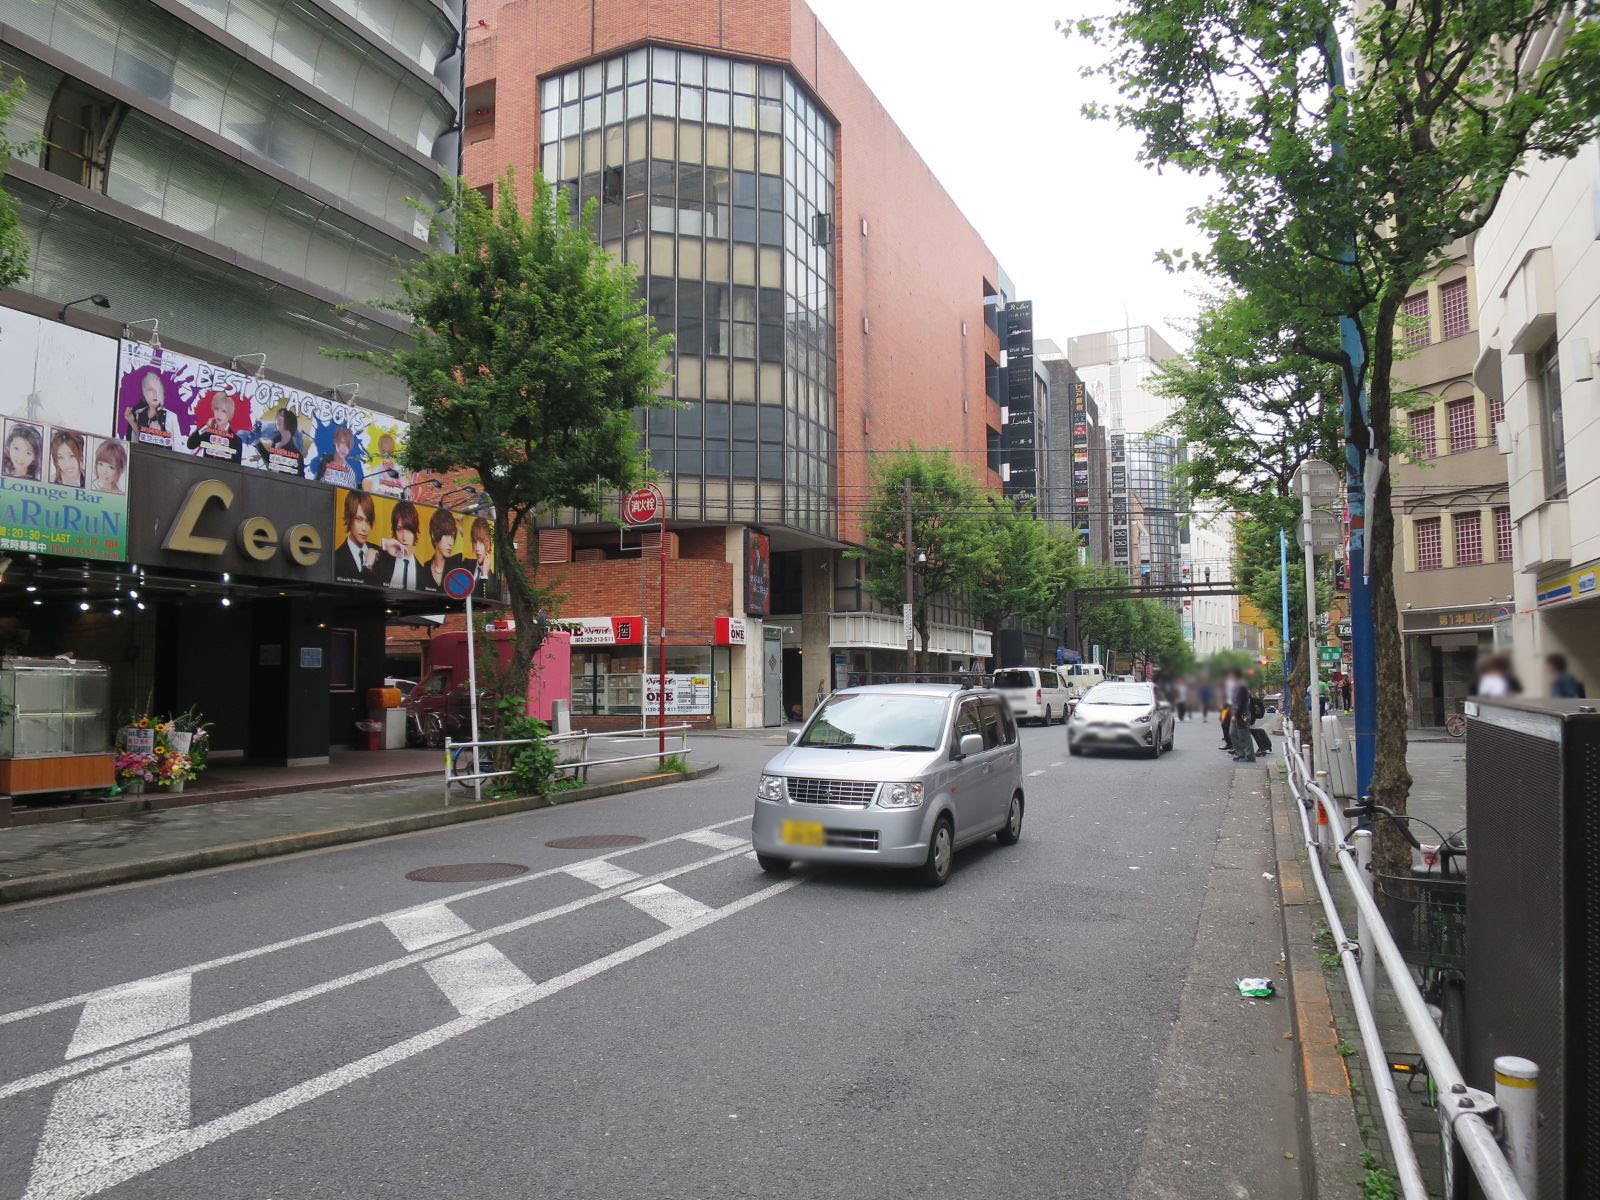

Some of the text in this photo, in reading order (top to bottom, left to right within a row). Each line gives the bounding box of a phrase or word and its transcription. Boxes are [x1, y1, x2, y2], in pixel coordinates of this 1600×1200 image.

[196, 364, 252, 401] BEST
[255, 382, 285, 408] OF
[320, 399, 366, 432] BOYS
[0, 477, 103, 504] Lounge Bar
[631, 497, 655, 513] 消火栓
[161, 479, 322, 566] Lee
[616, 621, 631, 639] 酒
[731, 629, 744, 640] ONE
